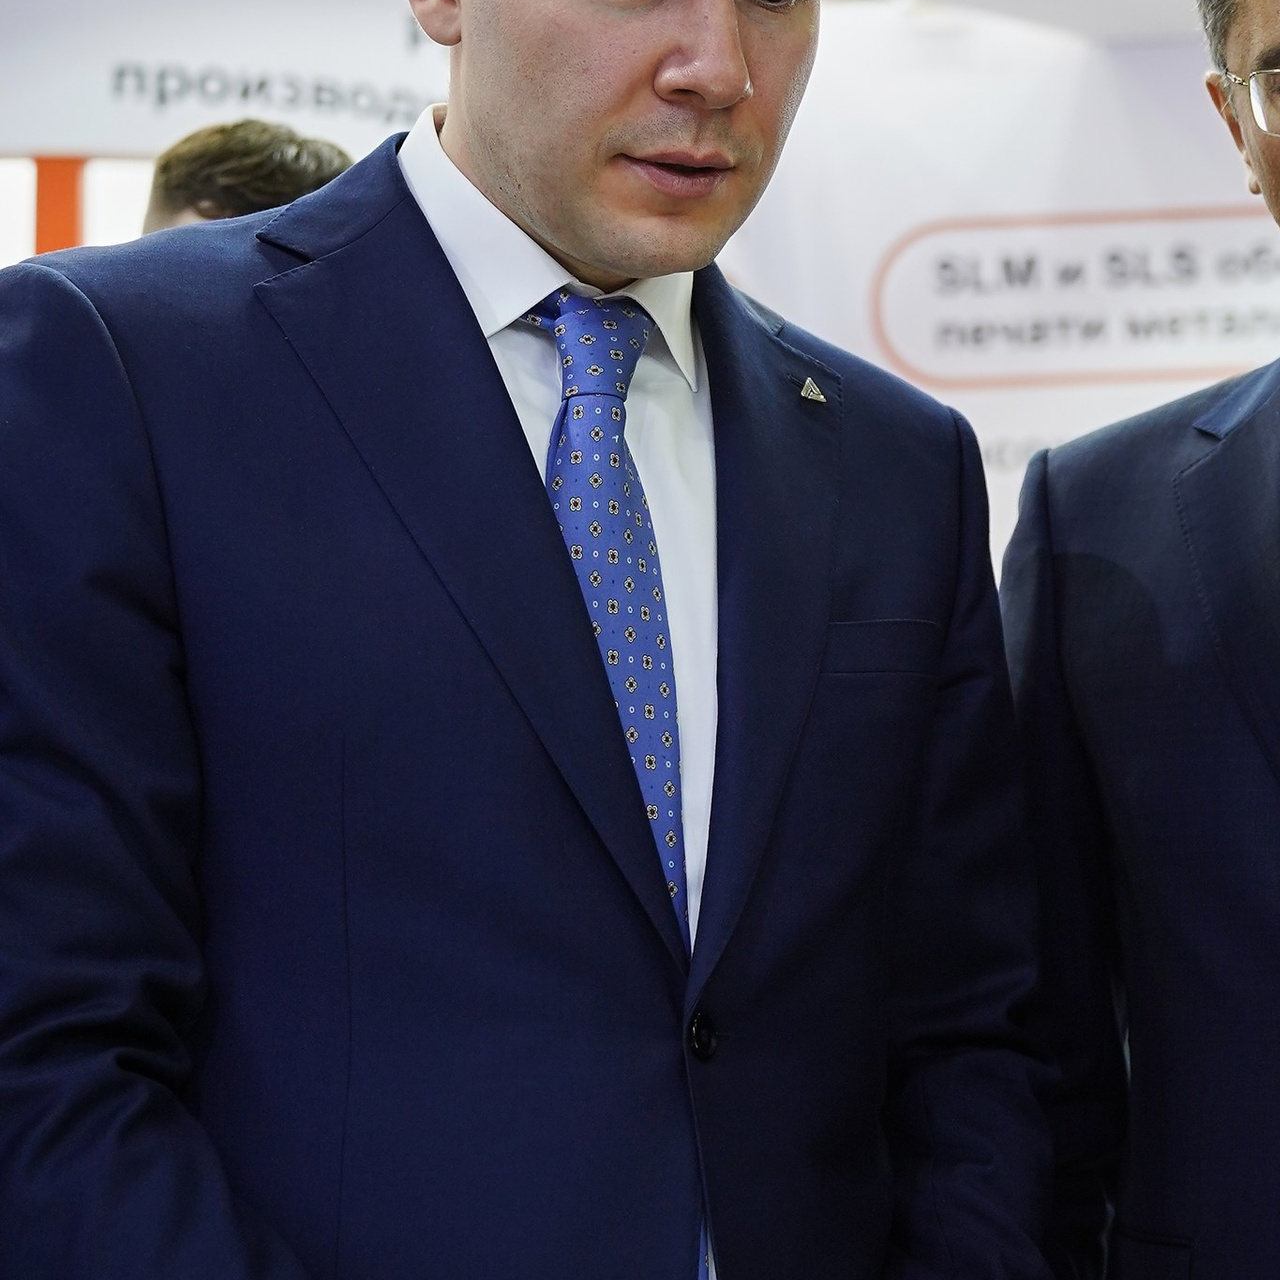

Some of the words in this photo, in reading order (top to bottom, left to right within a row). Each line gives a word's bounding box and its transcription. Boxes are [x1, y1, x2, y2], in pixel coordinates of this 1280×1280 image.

[112, 60, 446, 126] производ
[936, 250, 1039, 294] SLM
[1103, 244, 1198, 289] SLS
